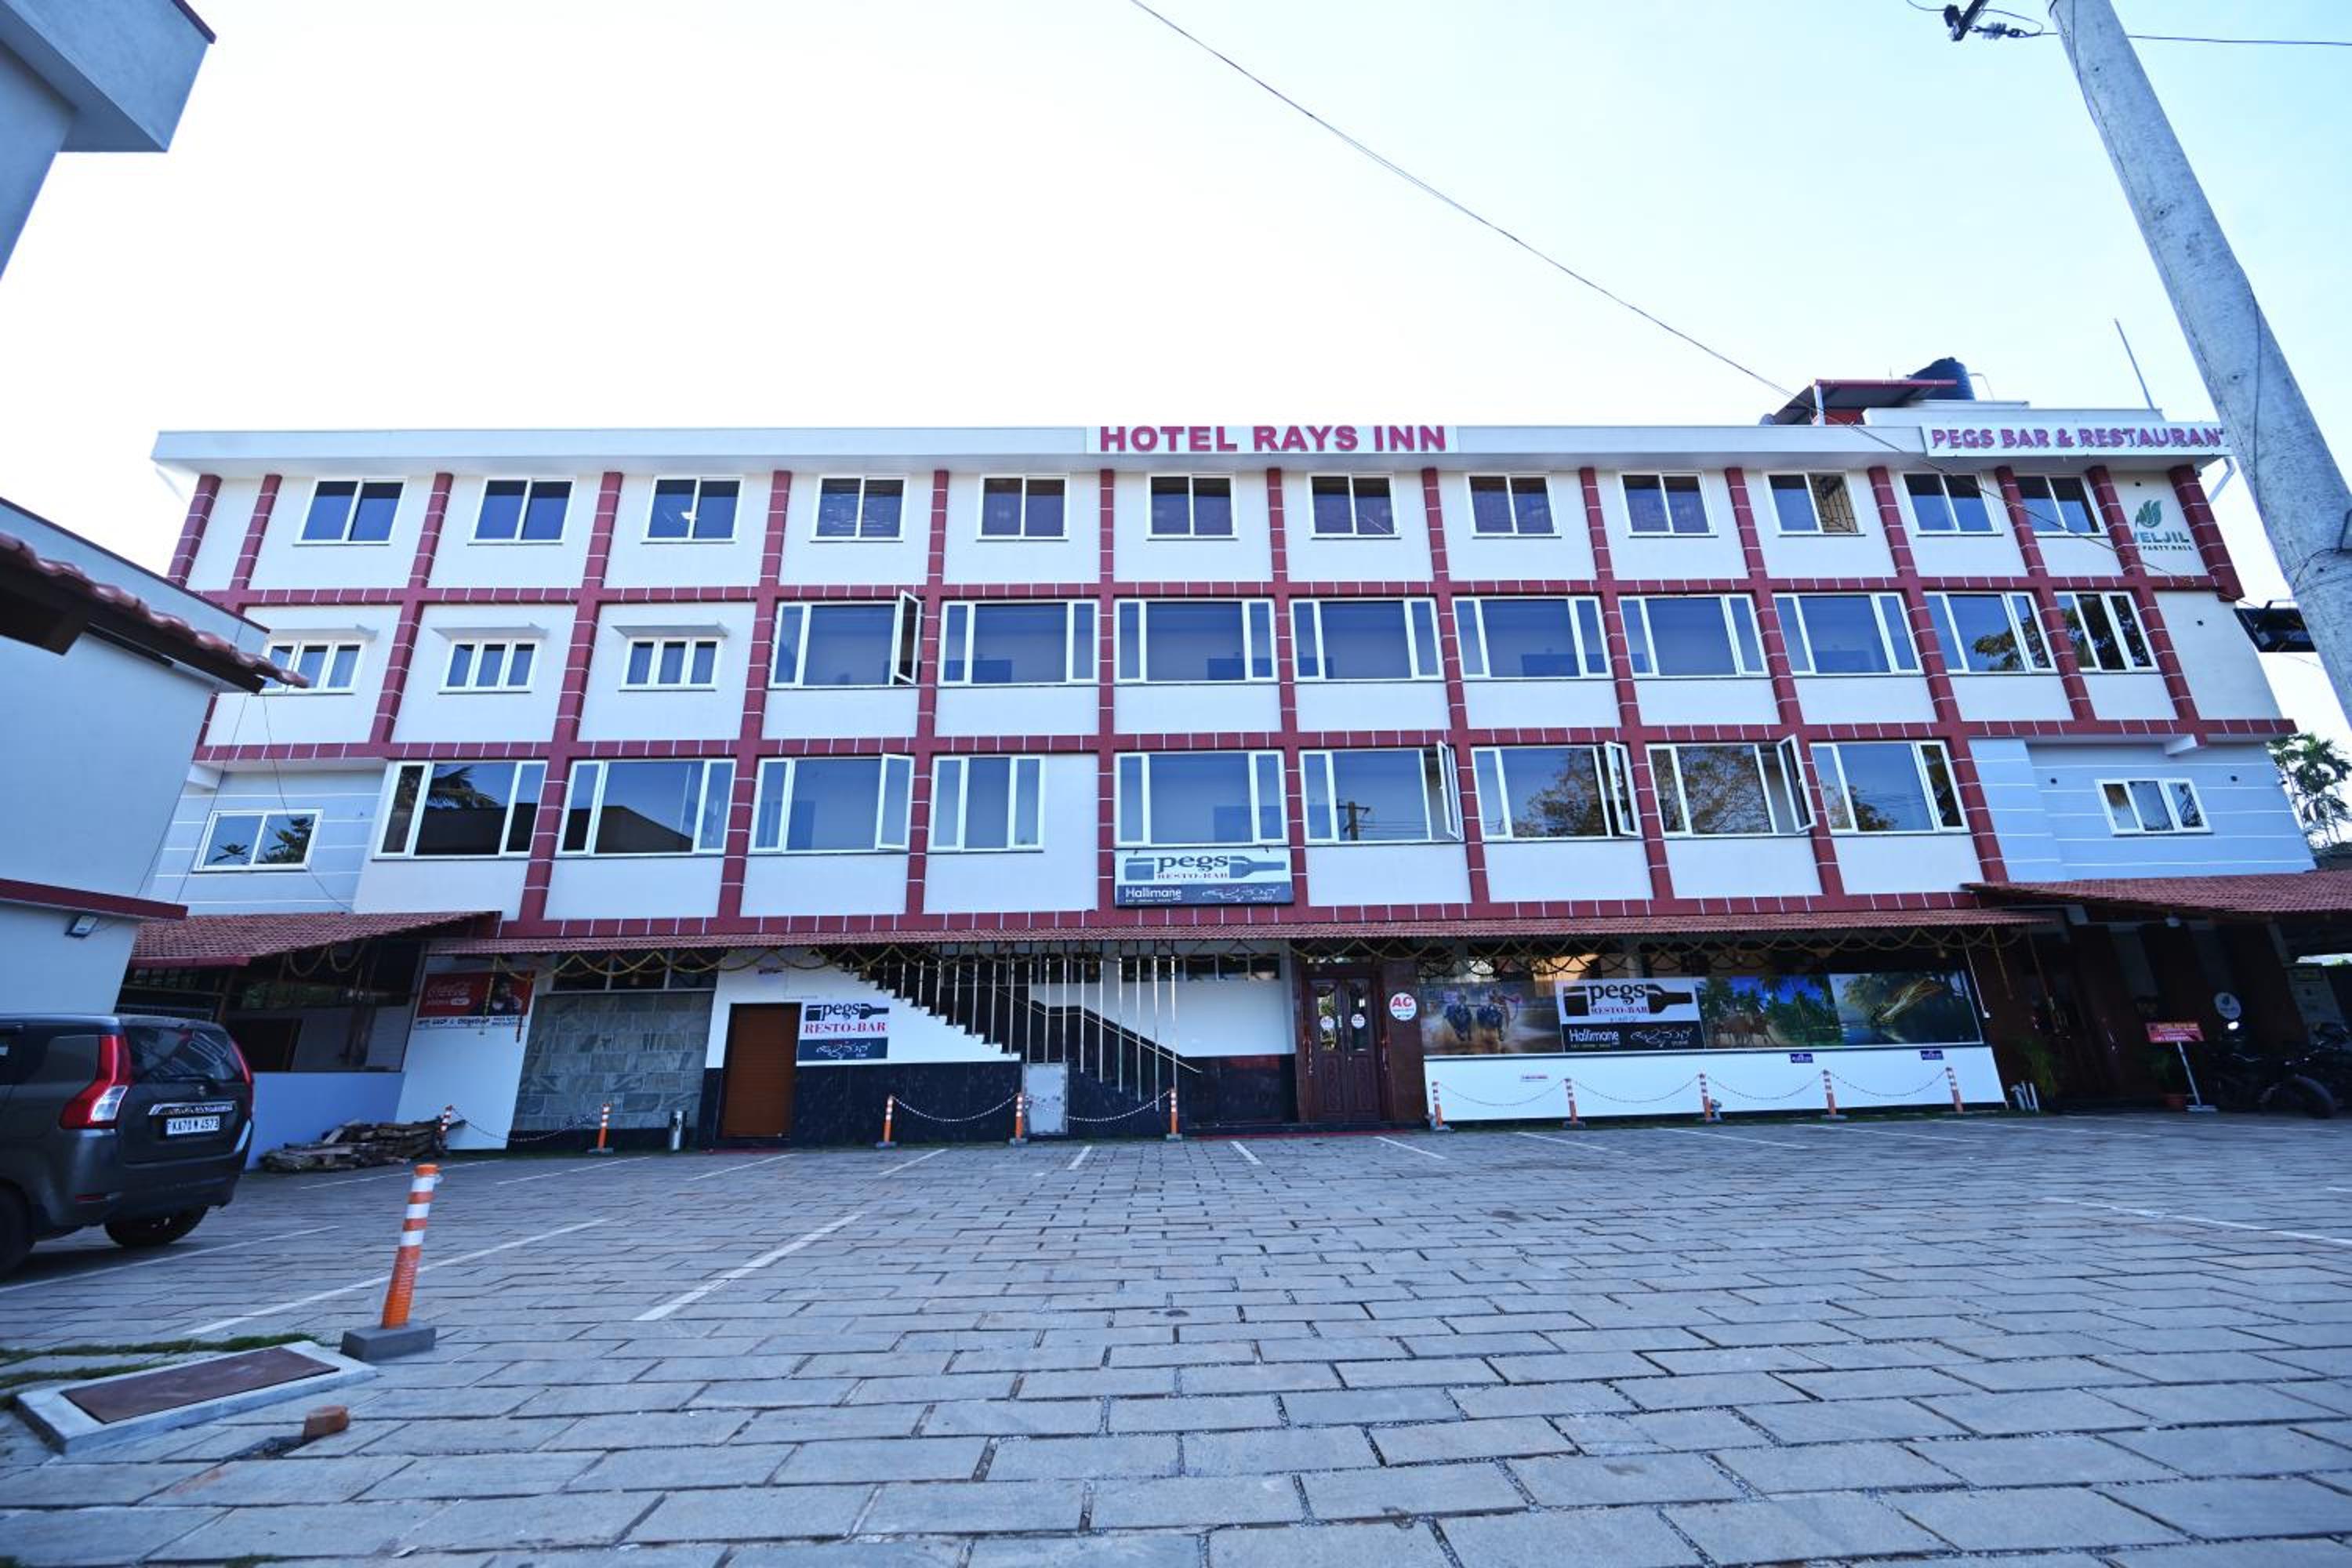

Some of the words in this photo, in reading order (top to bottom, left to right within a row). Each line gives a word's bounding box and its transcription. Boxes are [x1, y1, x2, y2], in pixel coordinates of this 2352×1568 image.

[1099, 426, 1237, 452] HOTEL
[1253, 426, 1359, 452] RAYS
[1374, 426, 1446, 452] INN
[1931, 428, 1995, 449] PEGS
[1999, 427, 2051, 449] BAR
[2056, 427, 2075, 448] &
[1156, 855, 1229, 873] pegs
[1125, 887, 1182, 898] Hallimane
[1392, 996, 1413, 1007] AC
[1588, 984, 1646, 1005] pegs
[821, 1004, 860, 1021] pegs
[804, 1022, 886, 1035] RESTO-BAR
[1569, 1028, 1619, 1042] Hallimane
